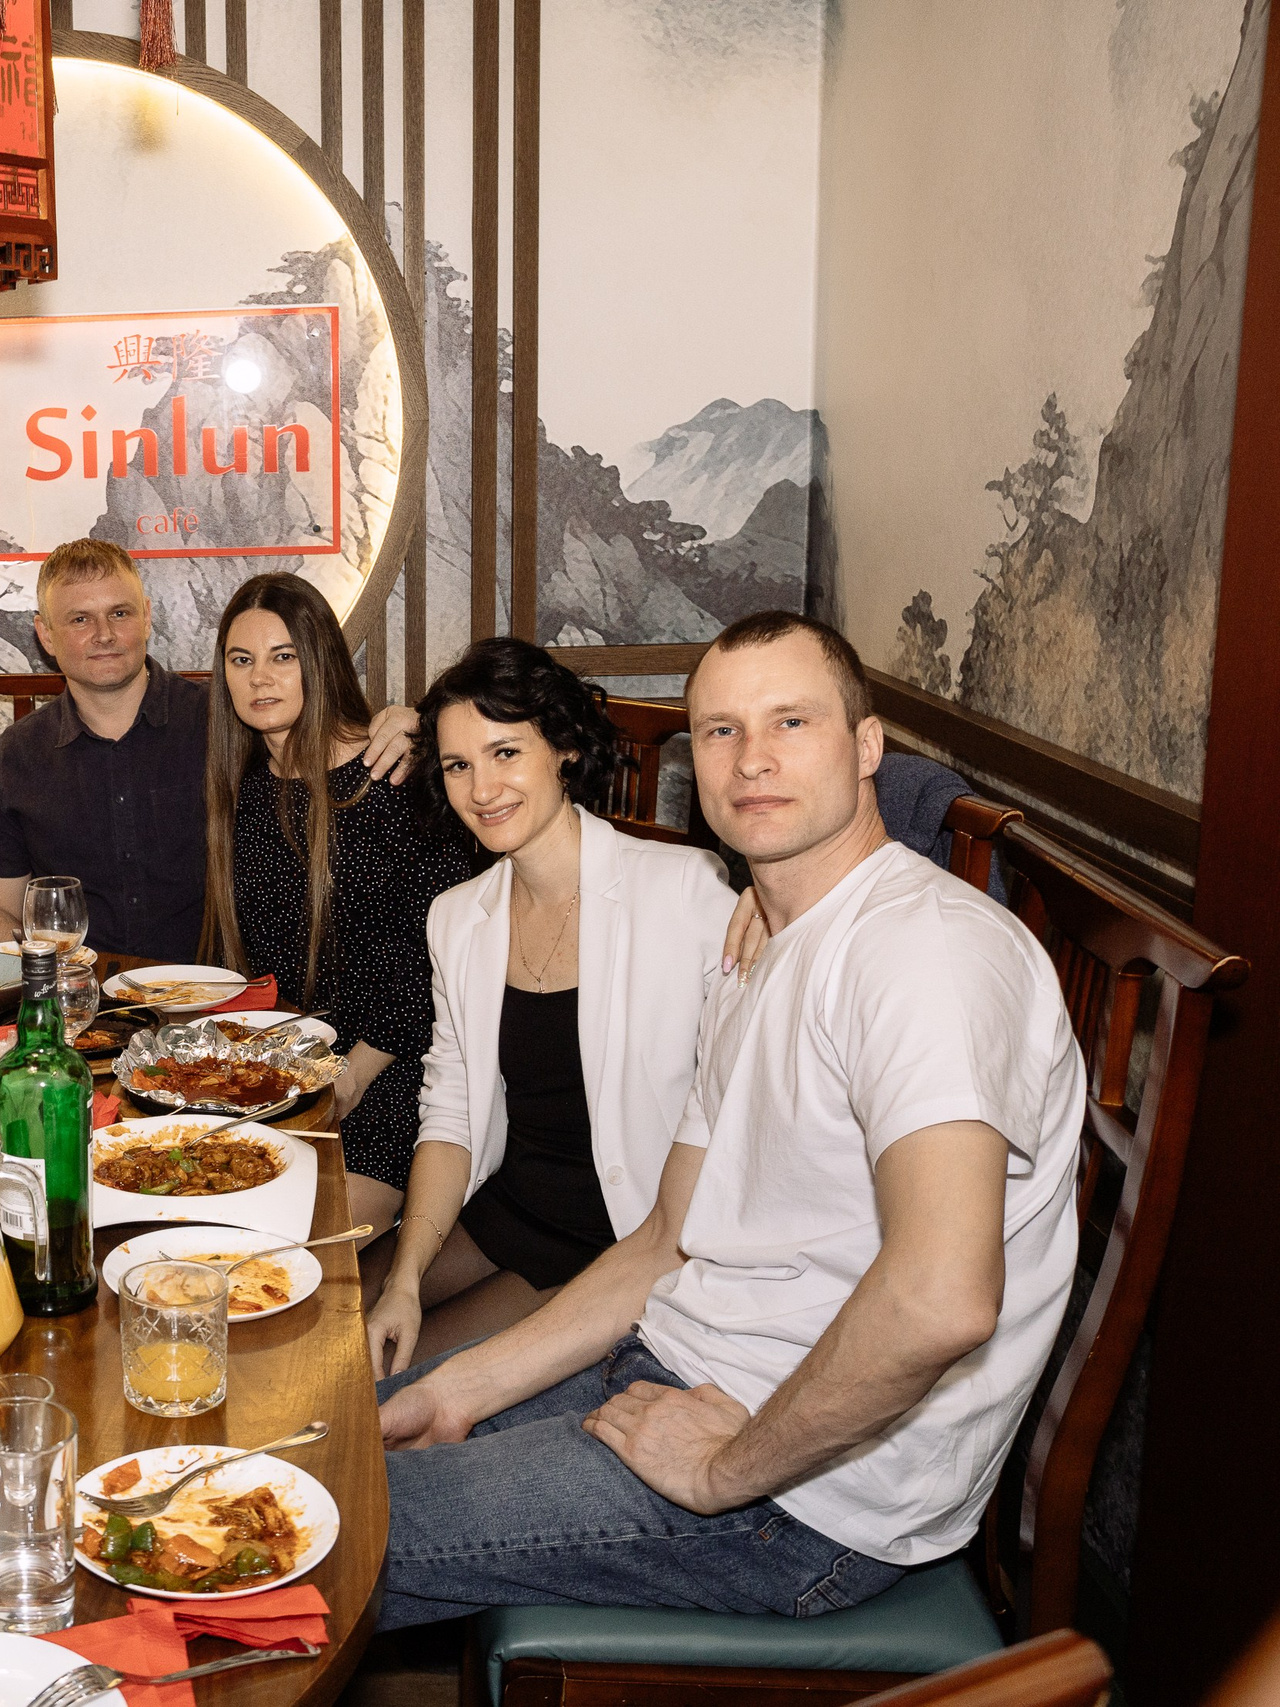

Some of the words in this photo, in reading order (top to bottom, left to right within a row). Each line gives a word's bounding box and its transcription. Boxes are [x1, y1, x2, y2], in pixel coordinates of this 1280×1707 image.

[106, 329, 224, 384] 興隆
[25, 394, 310, 481] Sinlun
[136, 506, 200, 535] café
